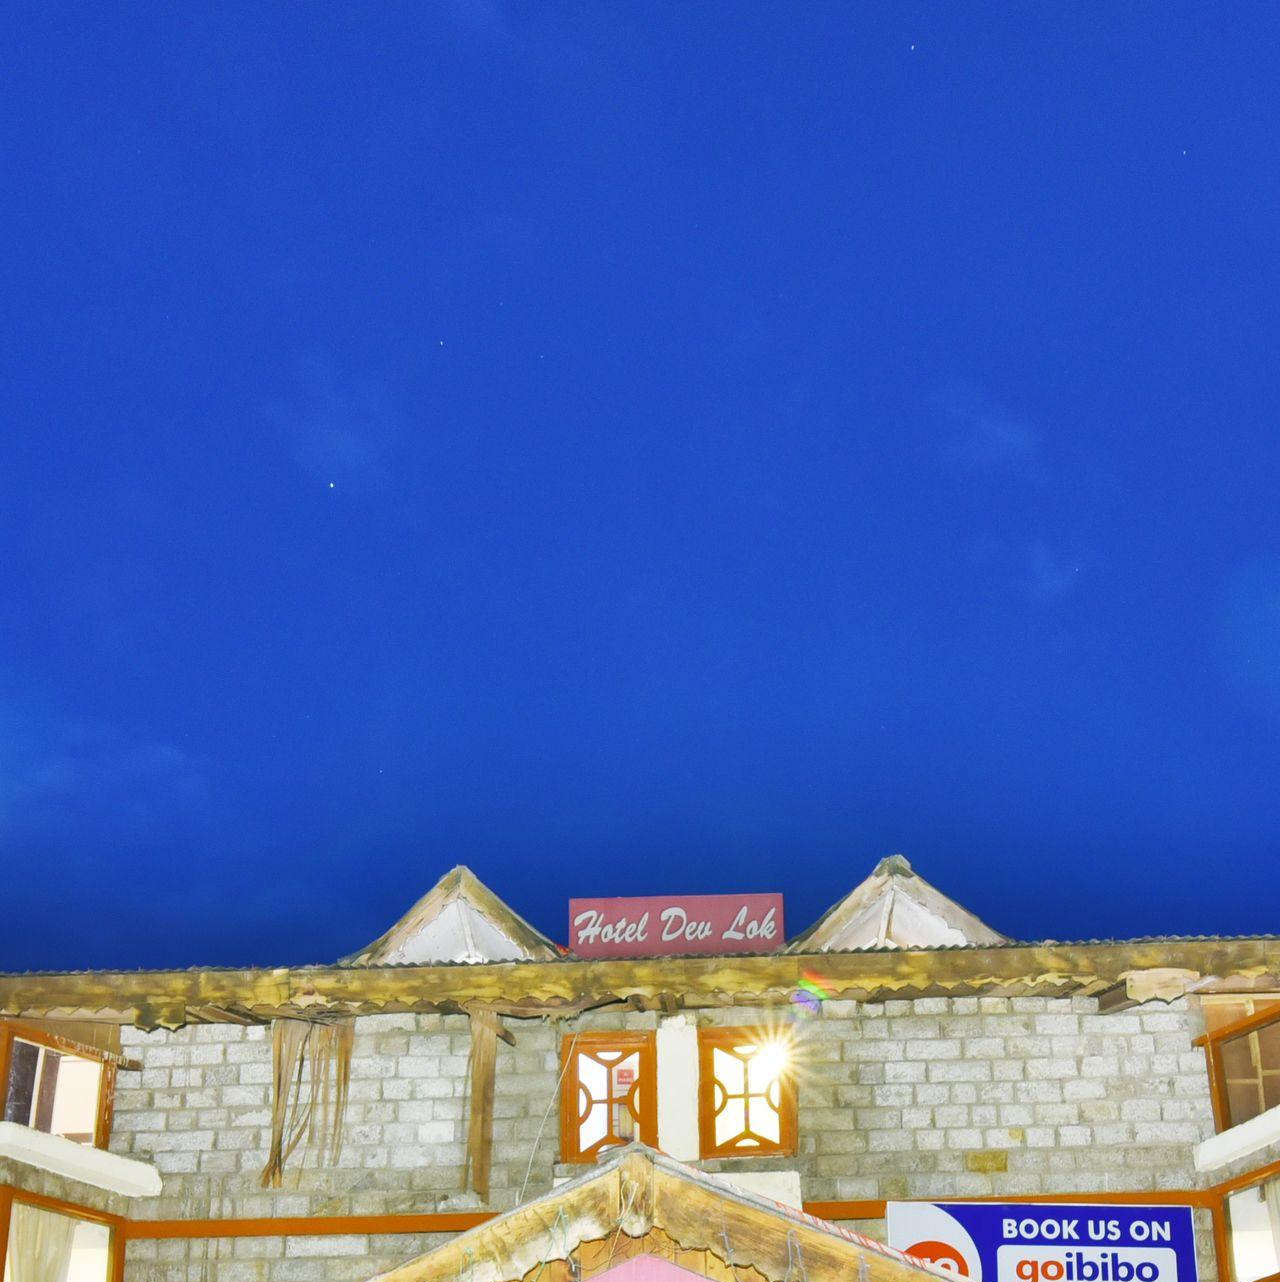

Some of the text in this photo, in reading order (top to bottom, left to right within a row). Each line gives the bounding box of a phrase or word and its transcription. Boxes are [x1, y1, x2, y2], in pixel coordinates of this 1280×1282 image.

[574, 905, 777, 945] Hotel Dev Lok
[1002, 1218, 1171, 1242] BOOK US ON
